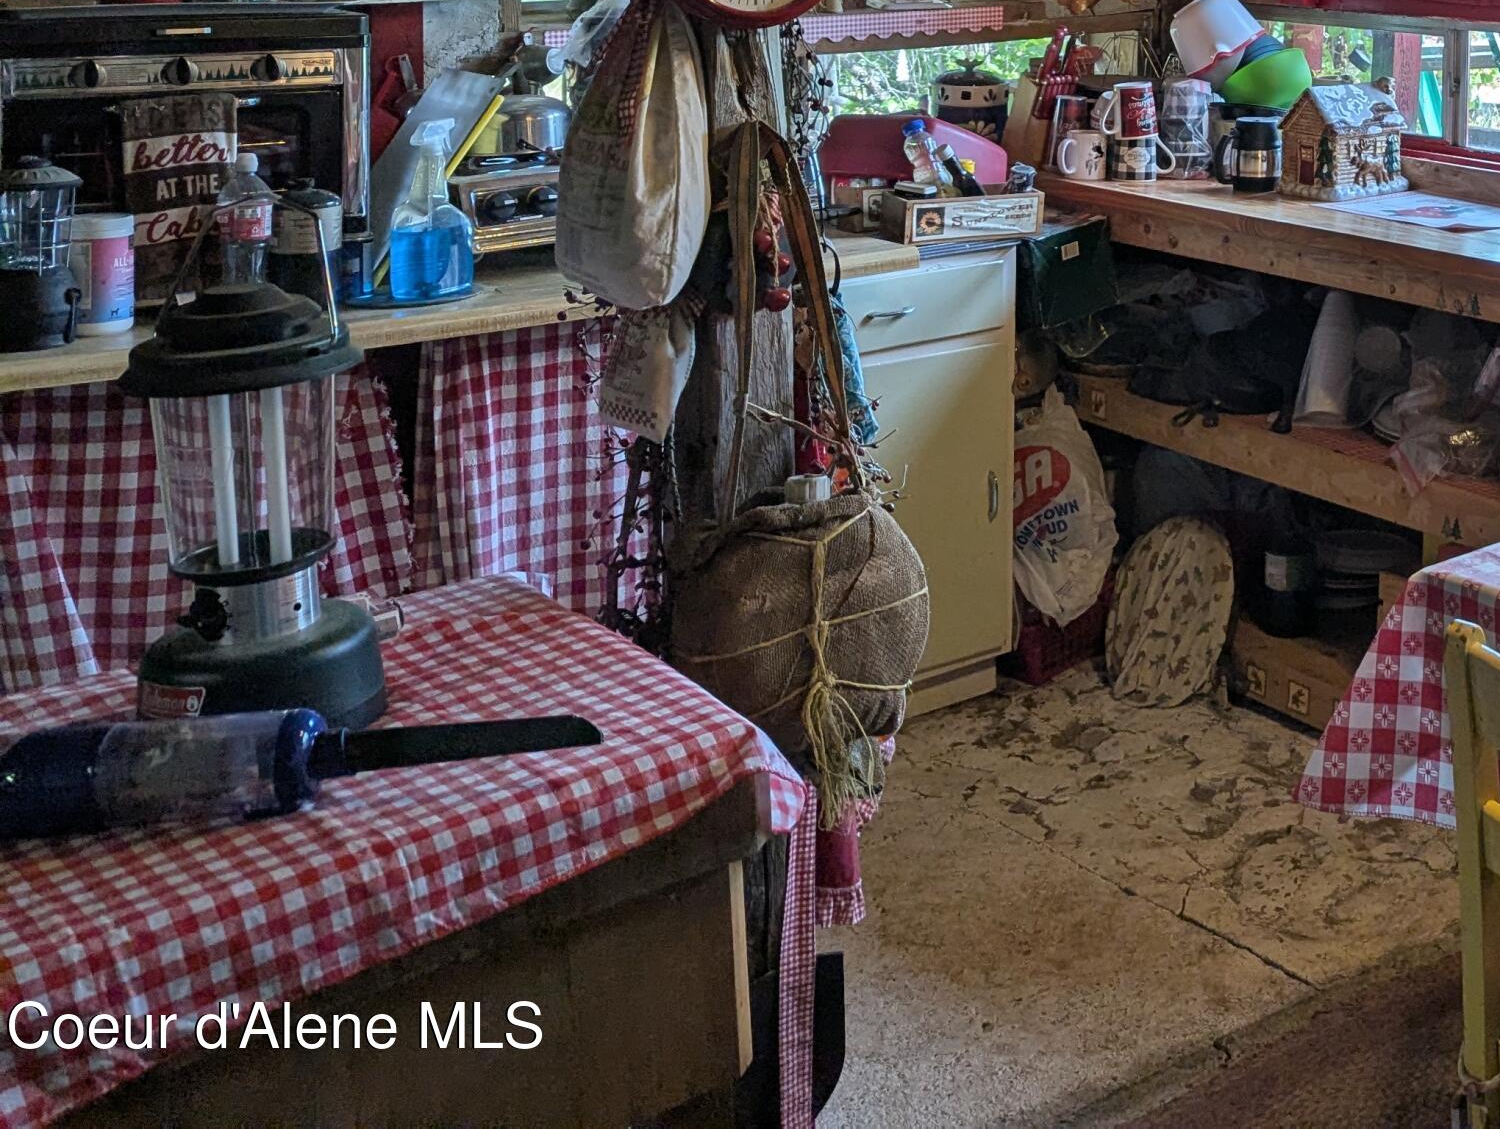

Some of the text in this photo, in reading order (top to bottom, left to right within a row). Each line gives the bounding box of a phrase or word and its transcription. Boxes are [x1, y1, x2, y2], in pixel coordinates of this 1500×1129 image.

[132, 135, 230, 172] better
[156, 173, 221, 201] AT THE
[135, 206, 221, 244] Cab
